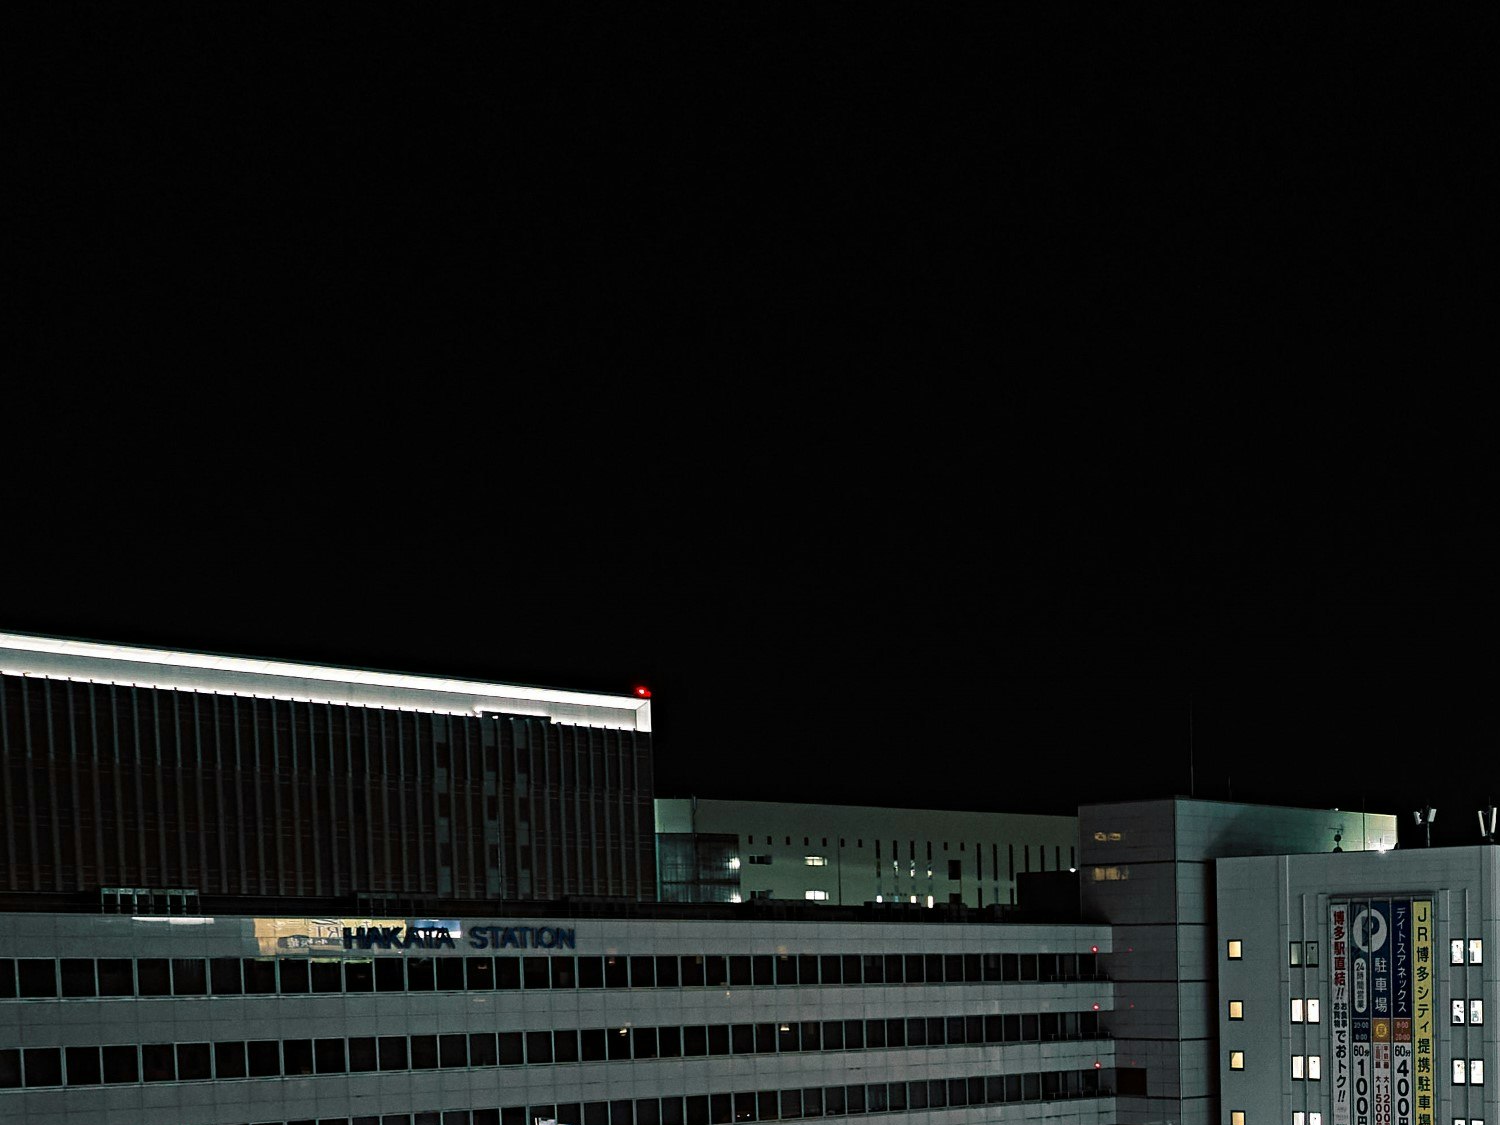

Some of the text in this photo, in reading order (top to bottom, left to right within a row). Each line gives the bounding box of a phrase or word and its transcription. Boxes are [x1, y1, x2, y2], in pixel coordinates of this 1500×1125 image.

[342, 927, 455, 950] HAKATA
[469, 927, 576, 950] STATION
[1374, 957, 1388, 1013] 駐車場
[1353, 1045, 1370, 1057] 60分
[1394, 1045, 1411, 1057] 60分
